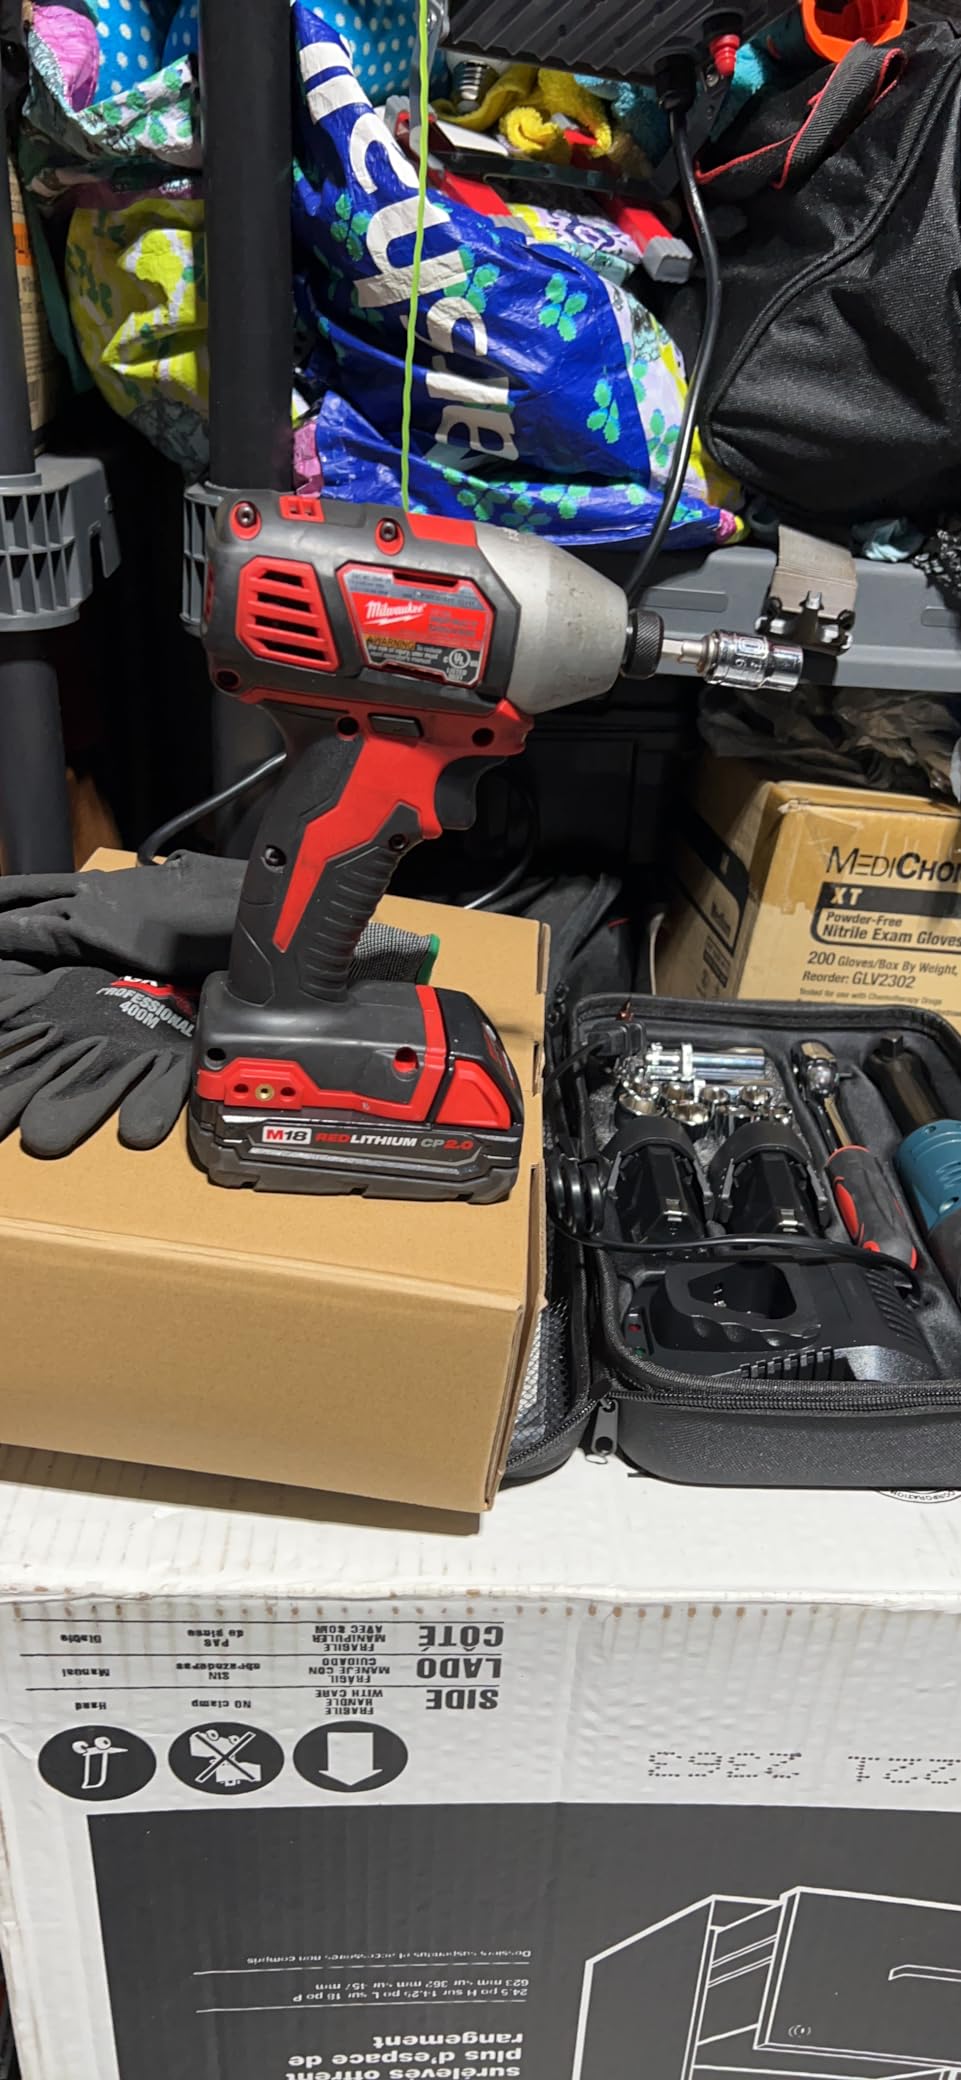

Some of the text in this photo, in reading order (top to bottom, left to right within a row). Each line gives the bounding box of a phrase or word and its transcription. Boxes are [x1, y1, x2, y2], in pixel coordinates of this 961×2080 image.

[364, 600, 427, 619] Milwaukee
[830, 887, 863, 906] XT
[826, 911, 903, 928] Powder-Free
[822, 925, 961, 948] Nitrile Exam Gloves
[807, 951, 959, 976] 200 Gloves/Box By Weight,
[802, 971, 916, 989] Reorder: GLV2302
[96, 988, 195, 1037] PROFESSIONAL
[119, 1001, 160, 1029] 400M
[266, 1129, 308, 1141] M18
[350, 1625, 383, 1633] AVEC
[204, 1638, 230, 1647] PAS
[312, 1634, 386, 1643] MANIPULER
[418, 1625, 504, 1652] CÔTÉ
[323, 1643, 375, 1652] FRAGILE
[321, 1657, 377, 1666] CUIDADO
[308, 1666, 390, 1675] MANEJE CON
[416, 1658, 502, 1679] LADO
[208, 1671, 230, 1680] SIN
[315, 1689, 383, 1698] WITH CARE
[191, 1699, 252, 1709] NO clamp
[326, 1698, 373, 1706] HANDLE
[425, 1689, 499, 1710] SIDE
[325, 1707, 374, 1716] FRAGILE
[648, 1751, 802, 1779] 2363
[397, 1980, 422, 1988] mm
[506, 1979, 529, 1987] 623
[306, 1991, 323, 2000] po
[501, 1988, 528, 1997] 24.5
[292, 1994, 302, 2002] P
[372, 2031, 524, 2049] rangement
[288, 2047, 522, 2069] plus d'espace de
